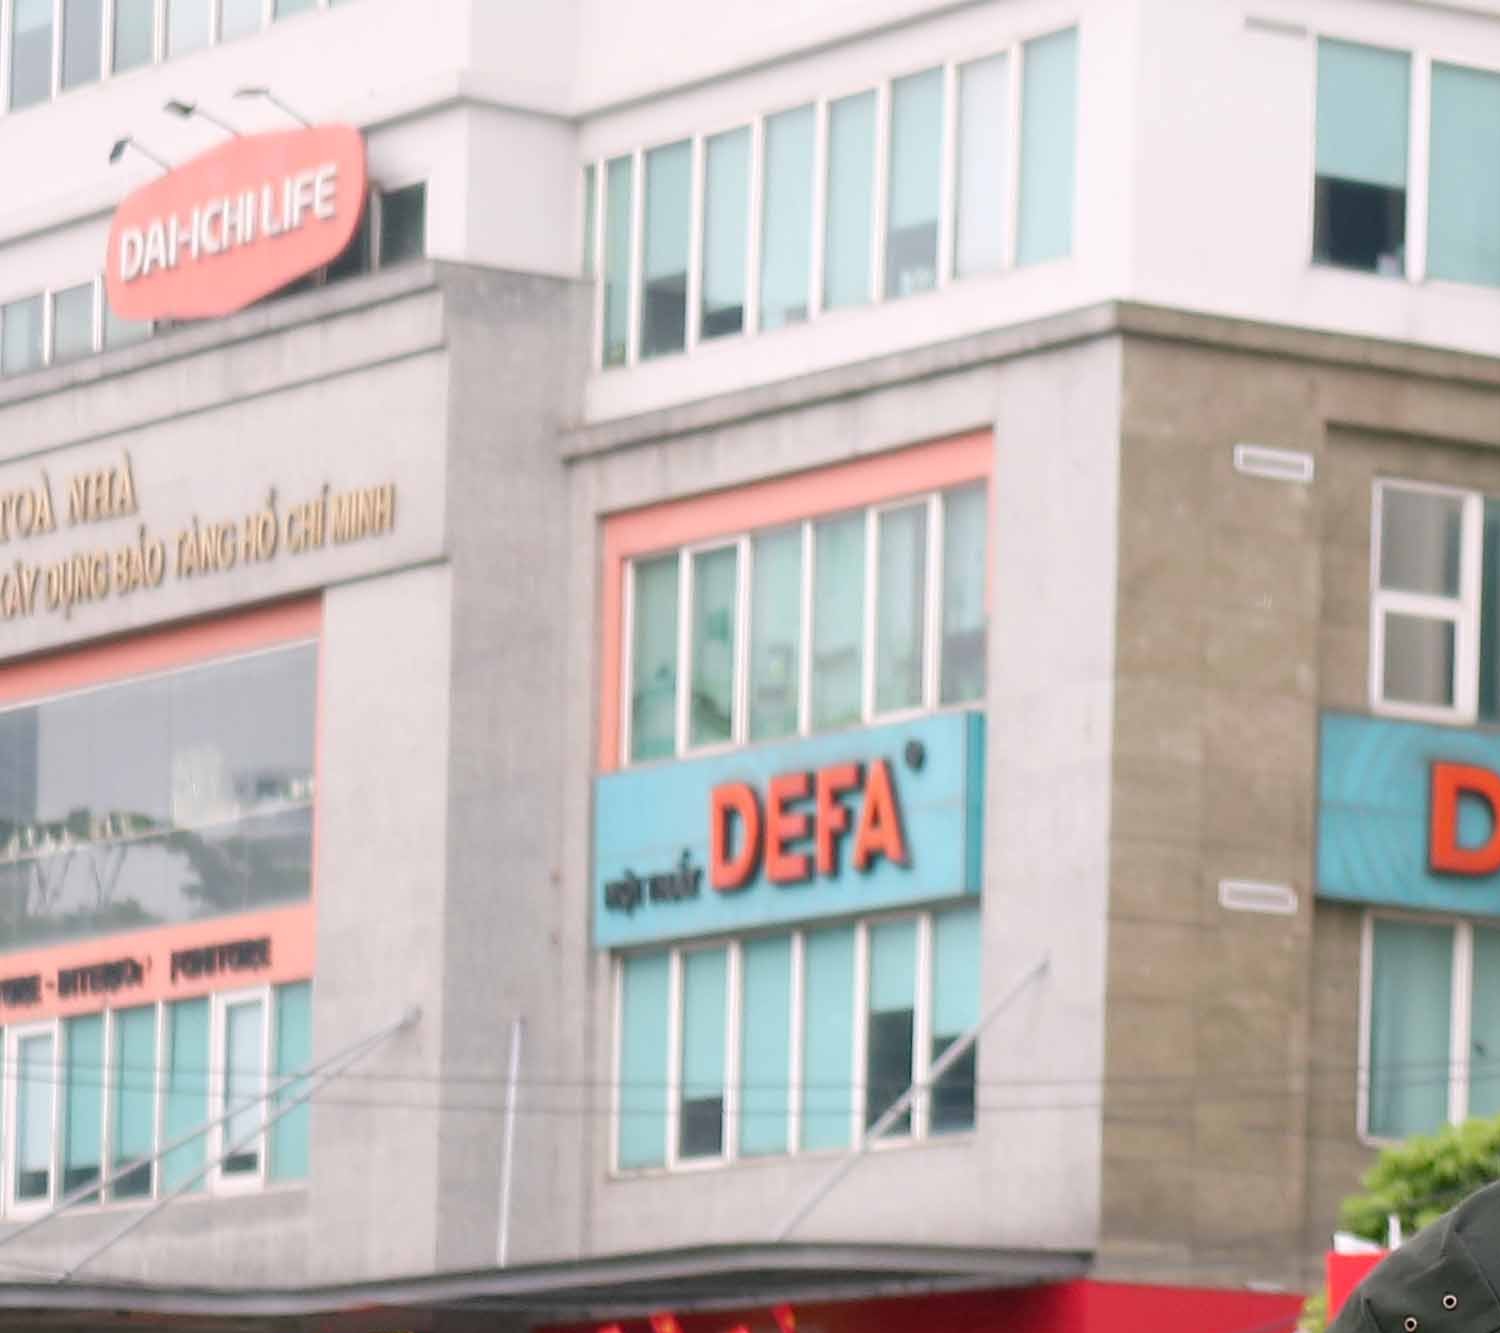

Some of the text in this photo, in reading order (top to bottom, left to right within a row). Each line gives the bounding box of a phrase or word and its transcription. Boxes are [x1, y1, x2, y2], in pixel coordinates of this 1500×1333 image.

[119, 162, 338, 282] DAI-ICHI LIFE
[66, 448, 140, 527] NHÀ
[175, 511, 237, 581] TÀNG
[285, 481, 329, 556] CHÍ
[331, 481, 396, 546] MINH
[709, 757, 912, 893] DEFA
